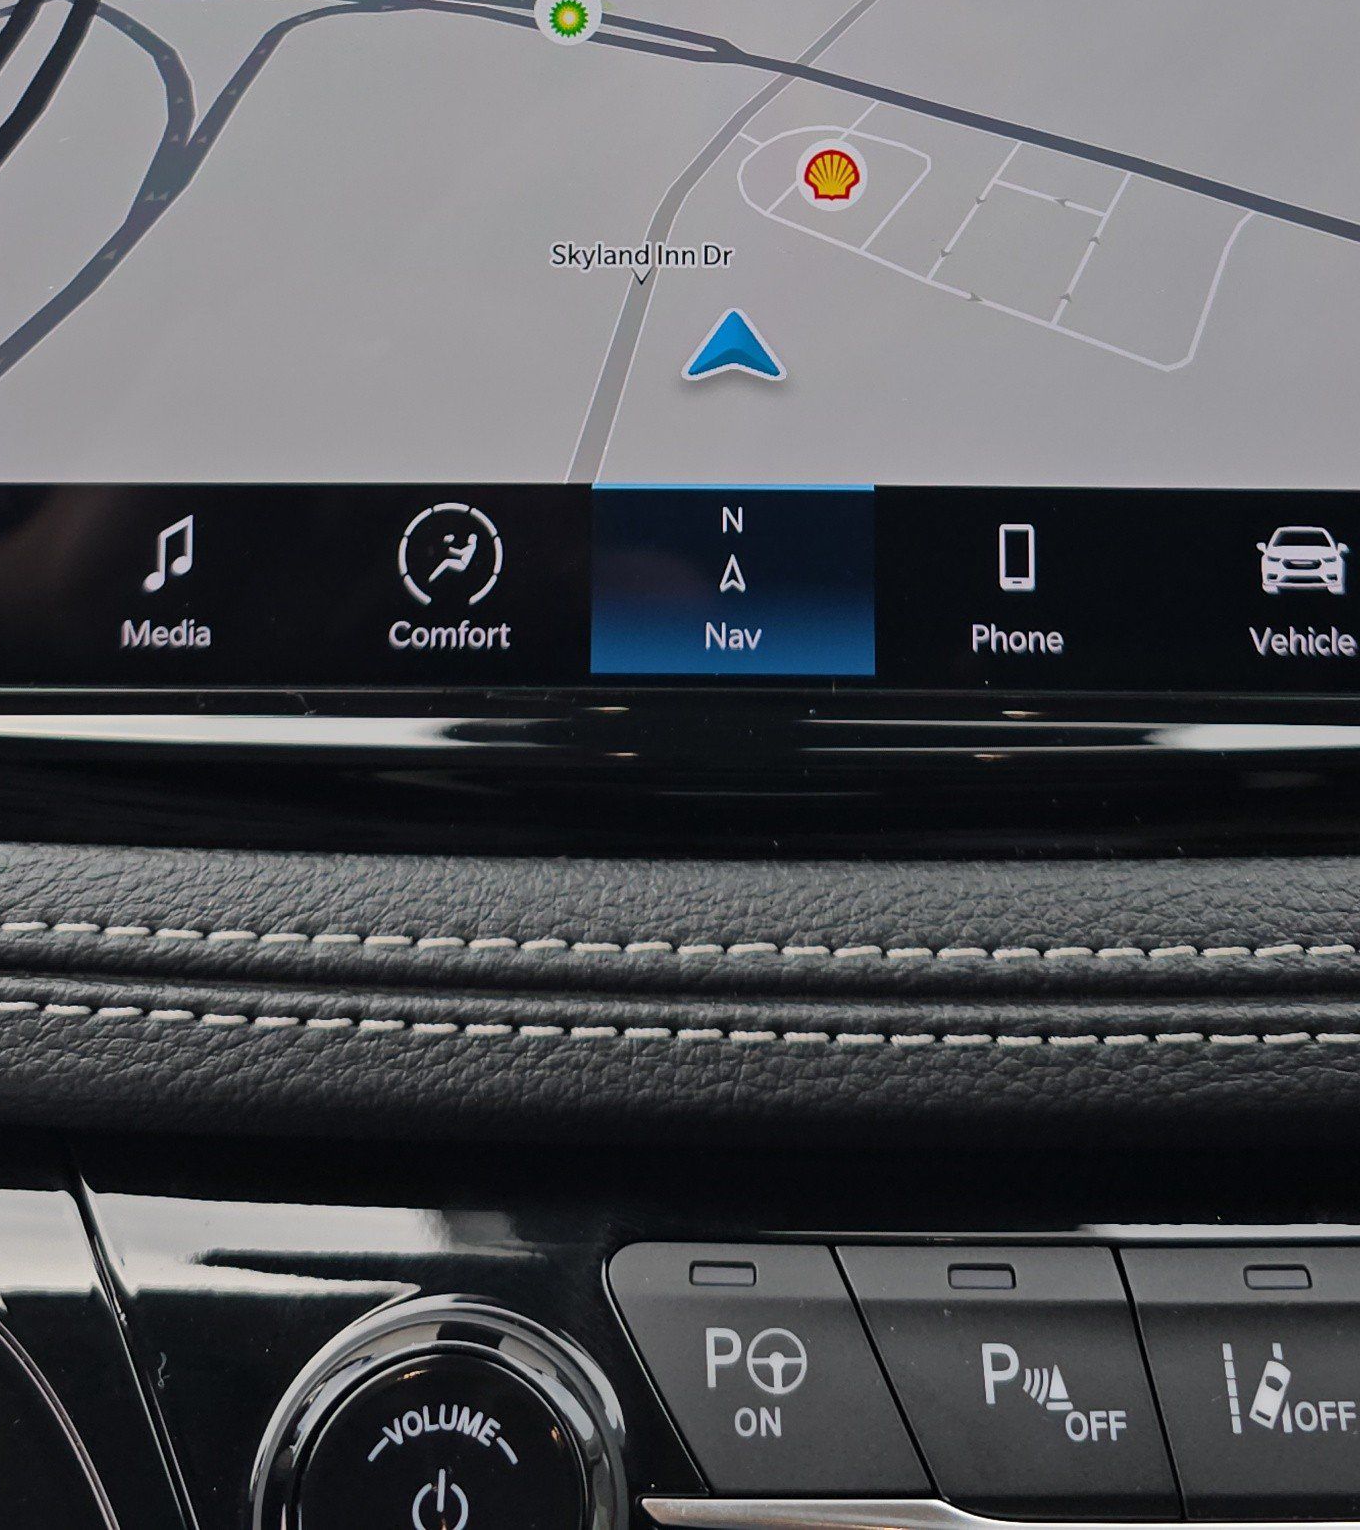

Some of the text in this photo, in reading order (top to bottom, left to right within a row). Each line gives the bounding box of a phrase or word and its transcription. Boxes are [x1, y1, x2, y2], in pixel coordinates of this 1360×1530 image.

[550, 243, 733, 272] Skyland Inn Dr
[721, 506, 744, 533] N
[121, 618, 212, 648] Media
[388, 618, 511, 649] Comfort
[703, 622, 762, 650] Nav
[971, 623, 1064, 654] Phone
[1250, 626, 1358, 656] Vehicle
[382, 1403, 502, 1447] VOLUME
[734, 1406, 783, 1438] ON
[1064, 1410, 1128, 1442] OFF
[1295, 1400, 1357, 1433] OFF
